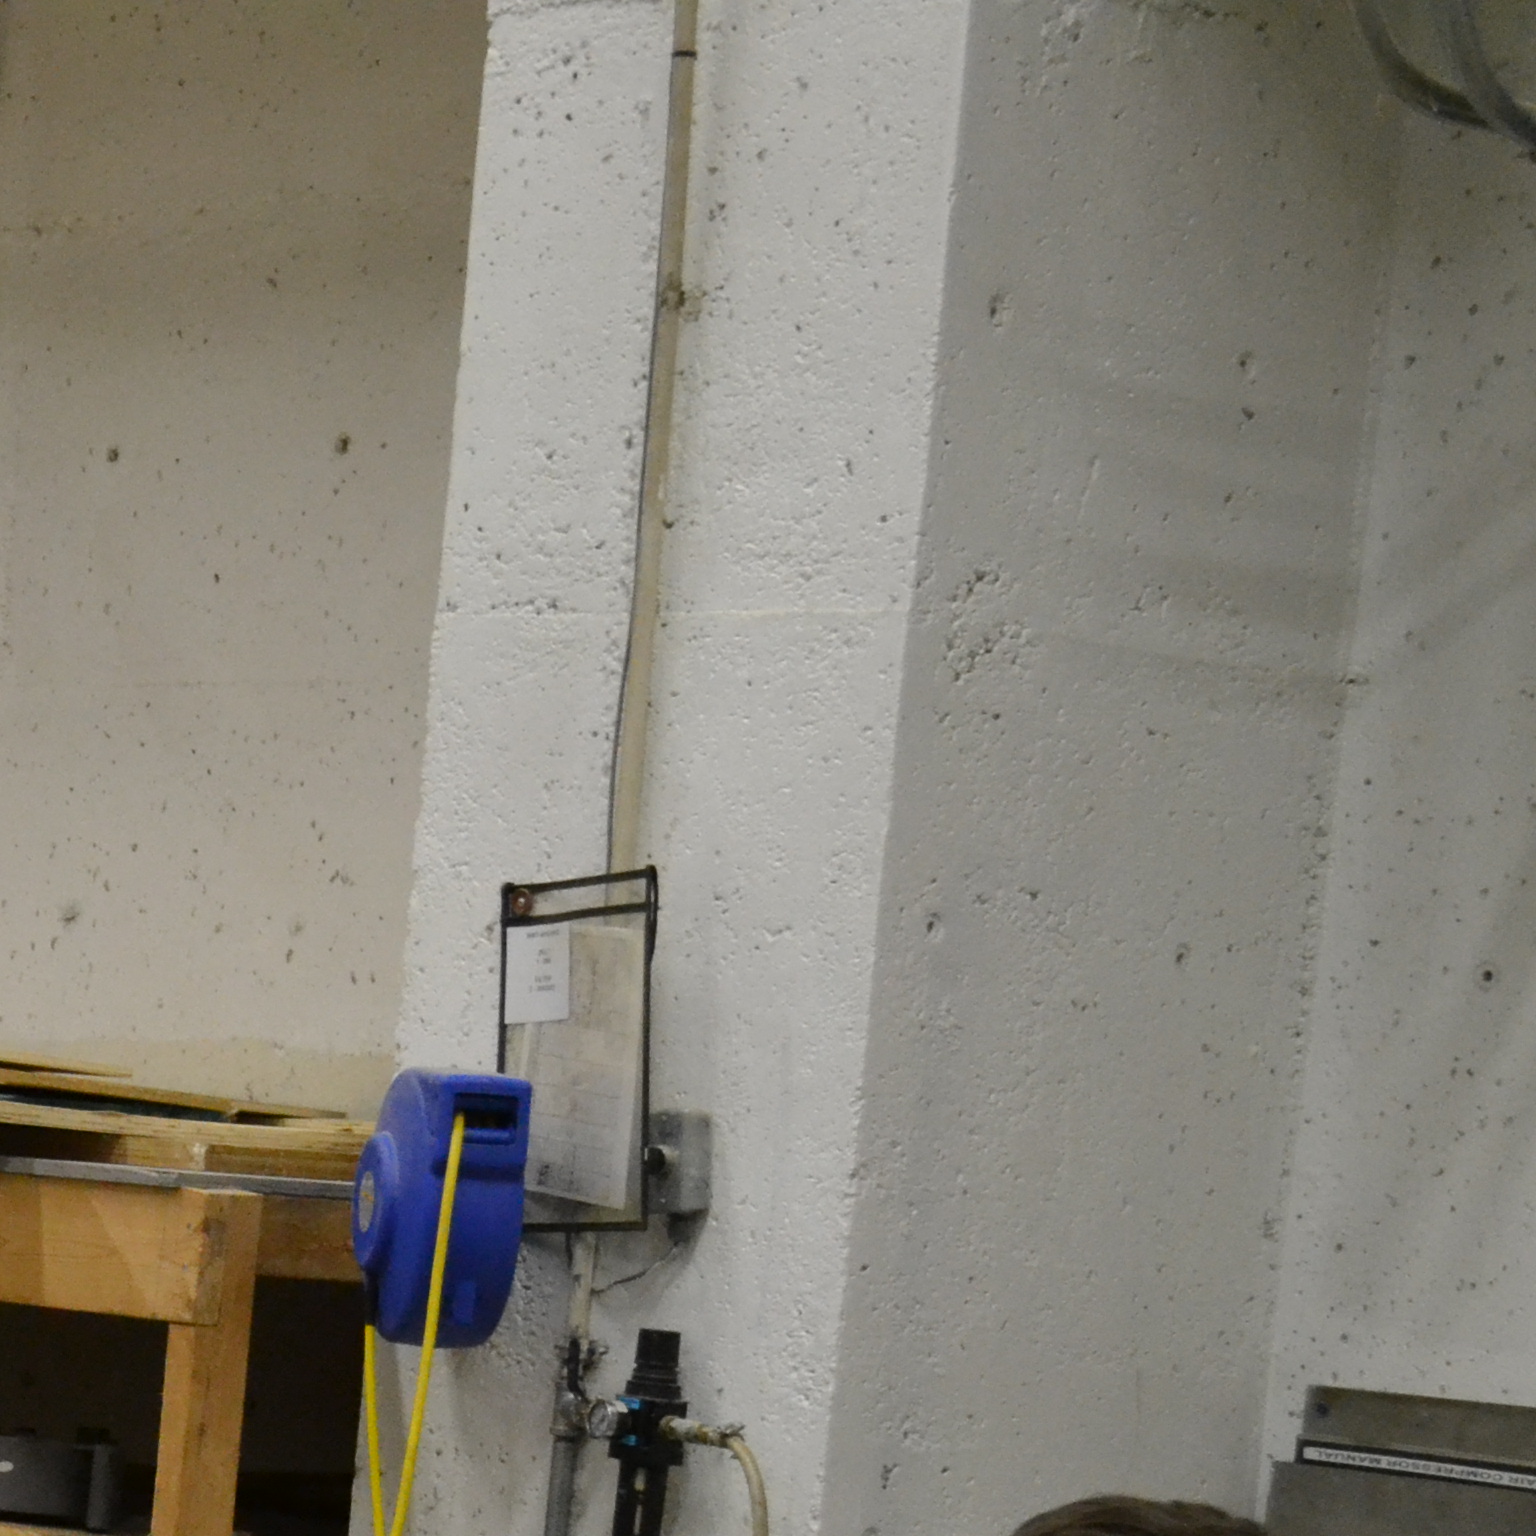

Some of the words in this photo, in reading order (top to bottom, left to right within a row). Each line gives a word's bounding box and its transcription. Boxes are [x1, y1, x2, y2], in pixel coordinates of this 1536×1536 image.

[1315, 1449, 1382, 1466] MANUAL
[1387, 1460, 1504, 1481] COMPRESSOR
[1508, 1475, 1536, 1488] AIR
